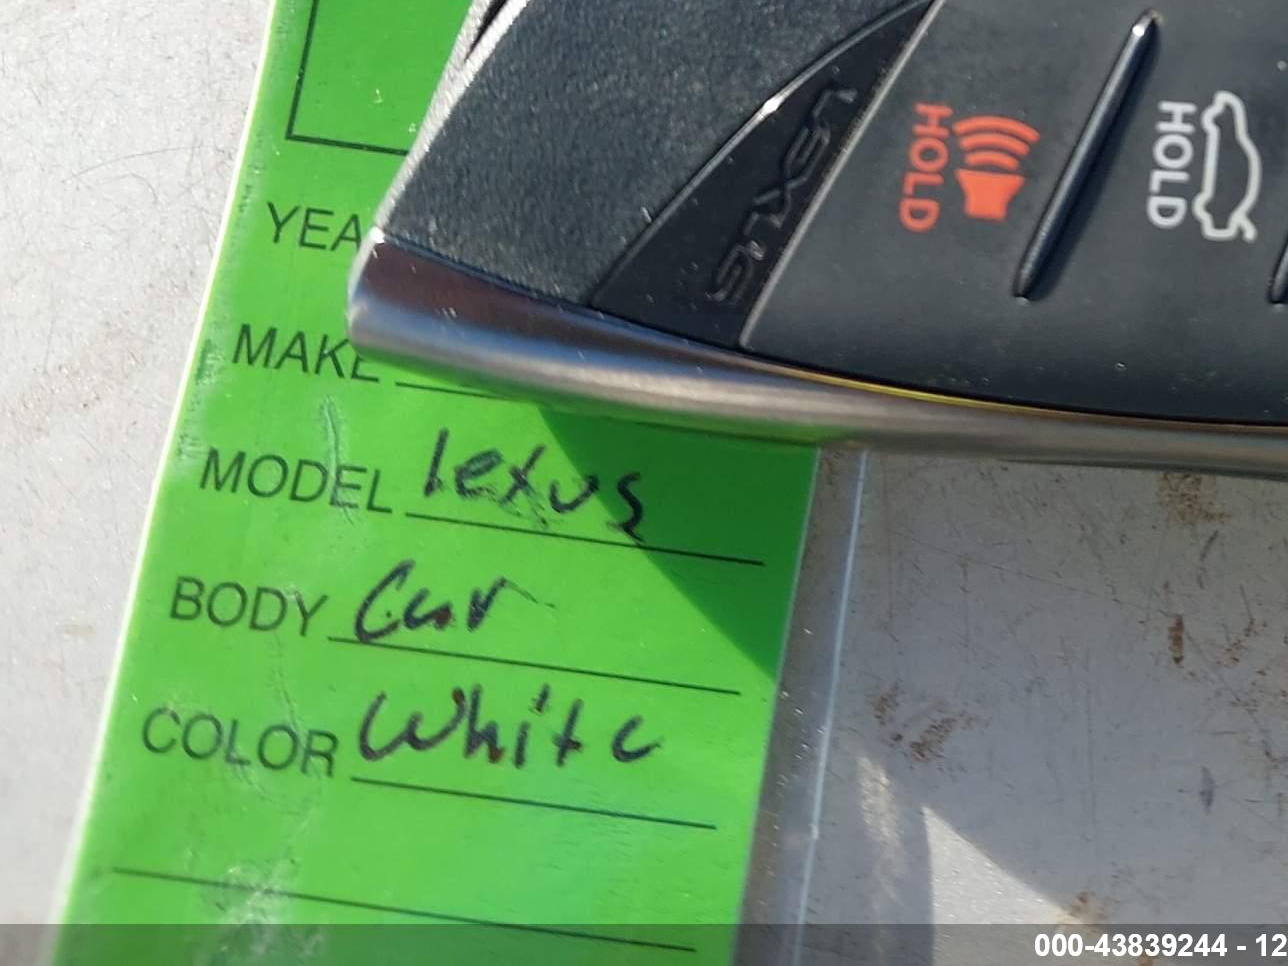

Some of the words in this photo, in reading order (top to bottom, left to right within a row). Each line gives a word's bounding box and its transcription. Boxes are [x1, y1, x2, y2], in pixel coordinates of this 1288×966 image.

[899, 103, 954, 232] HOLD
[1146, 100, 1198, 227] HOLD
[266, 201, 362, 252] YEA
[200, 448, 393, 514] MODEL
[169, 576, 328, 636] BODY
[142, 707, 340, 778] COLOR
